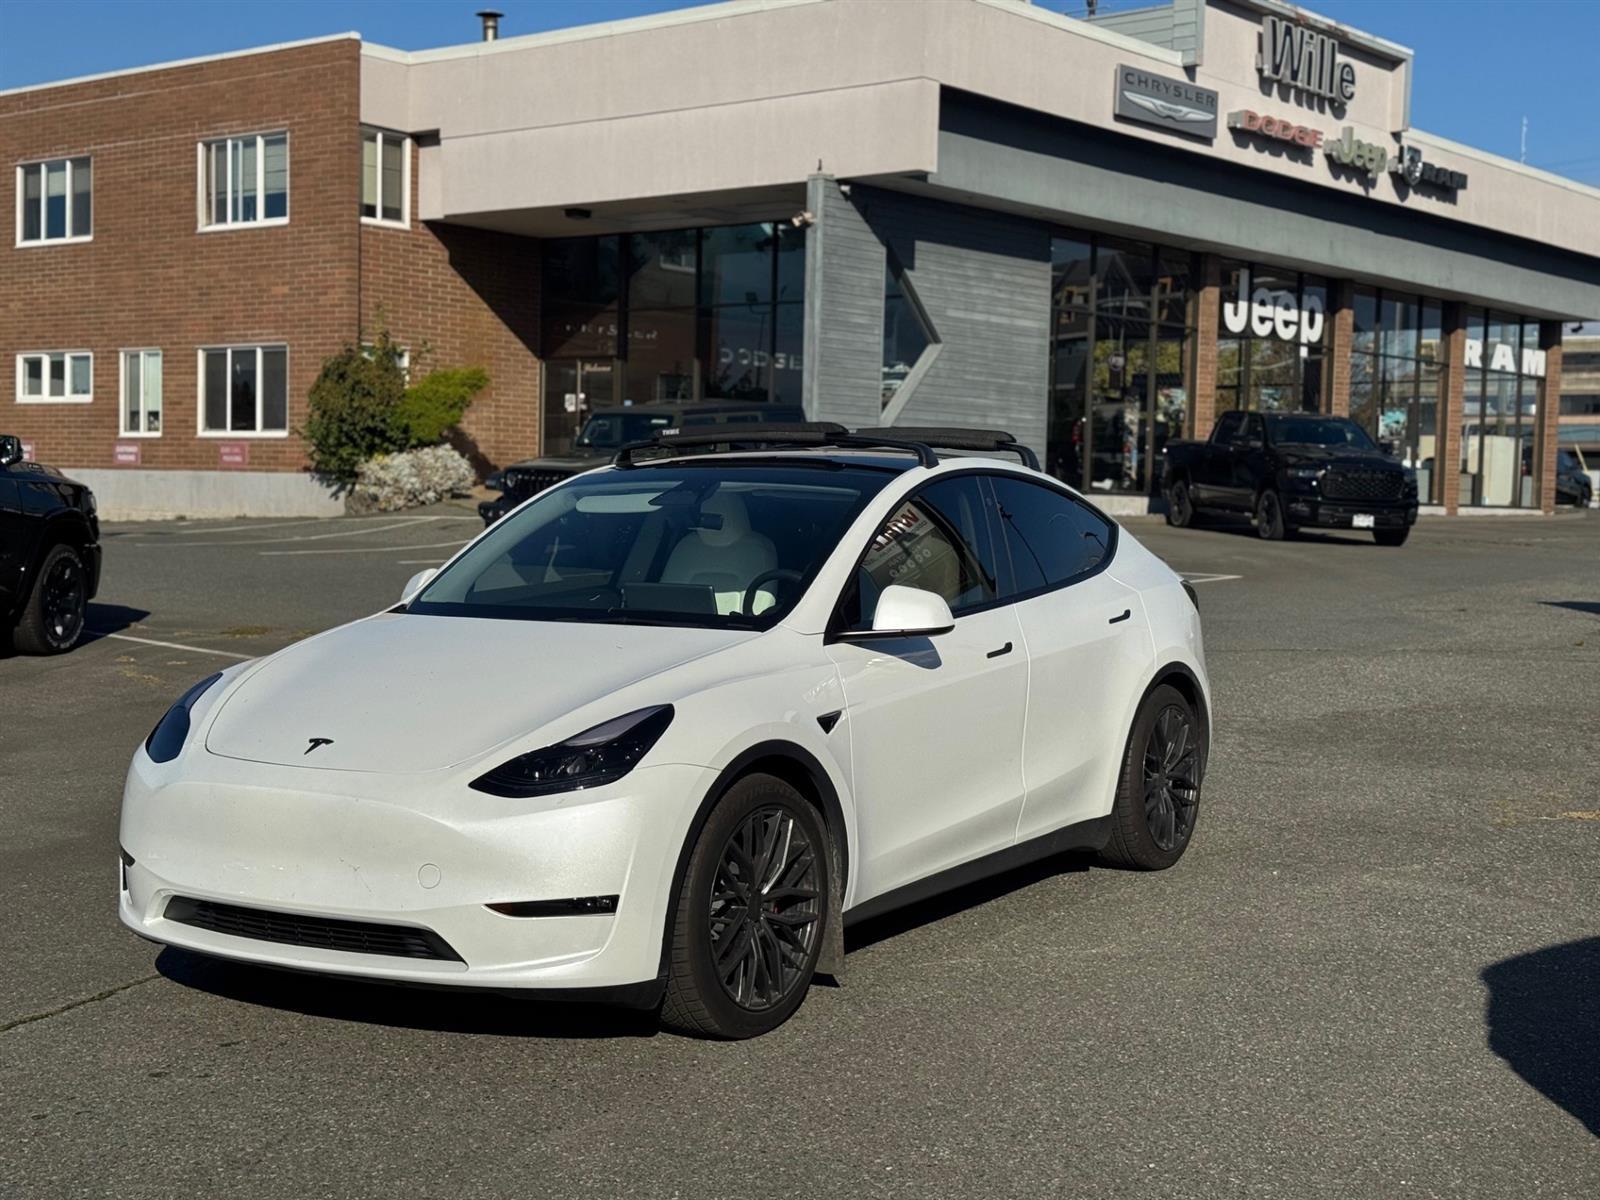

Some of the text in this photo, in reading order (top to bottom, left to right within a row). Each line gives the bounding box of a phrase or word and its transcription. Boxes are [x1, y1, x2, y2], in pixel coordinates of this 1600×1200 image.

[1264, 16, 1356, 101] Wille
[1124, 71, 1215, 108] CHRYSLER
[1240, 110, 1323, 149] DODGE
[1332, 126, 1387, 179] Jeep
[1421, 161, 1467, 190] RAM
[1223, 268, 1324, 358] Jeep
[1463, 339, 1547, 377] RAM
